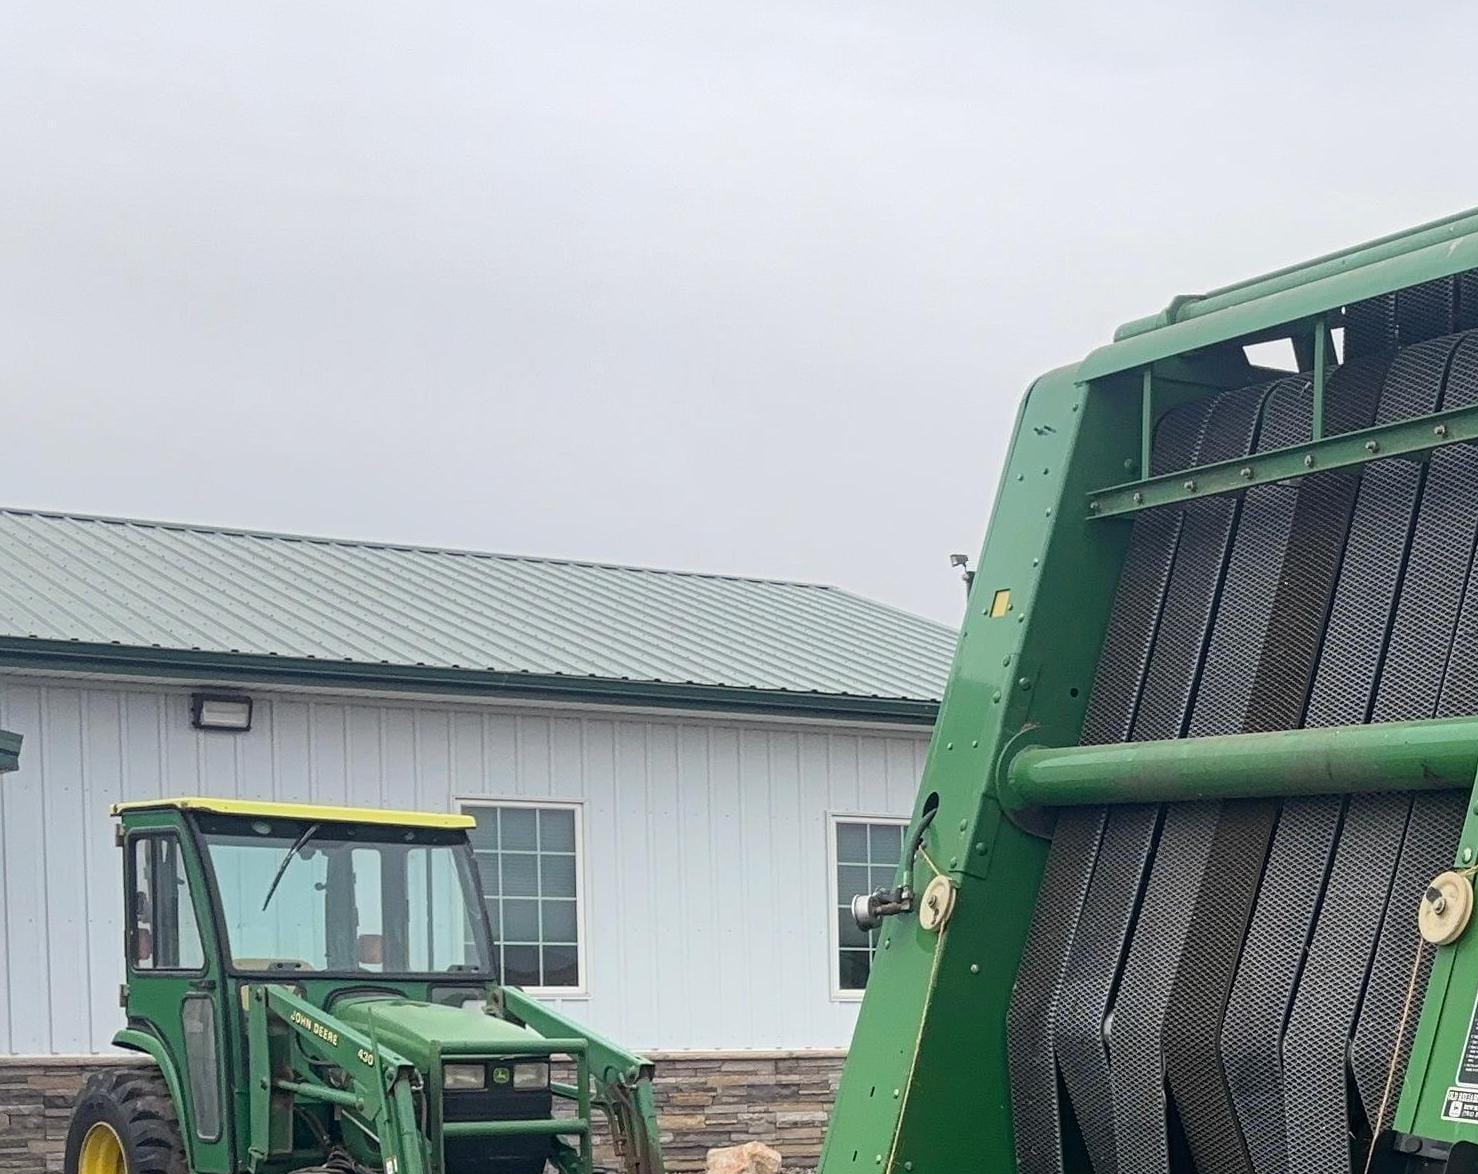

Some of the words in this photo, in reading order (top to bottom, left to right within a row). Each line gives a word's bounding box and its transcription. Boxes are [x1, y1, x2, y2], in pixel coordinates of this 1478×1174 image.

[290, 1010, 312, 1030] JOHN
[313, 1023, 338, 1046] DEERE
[357, 1049, 374, 1066] 430
